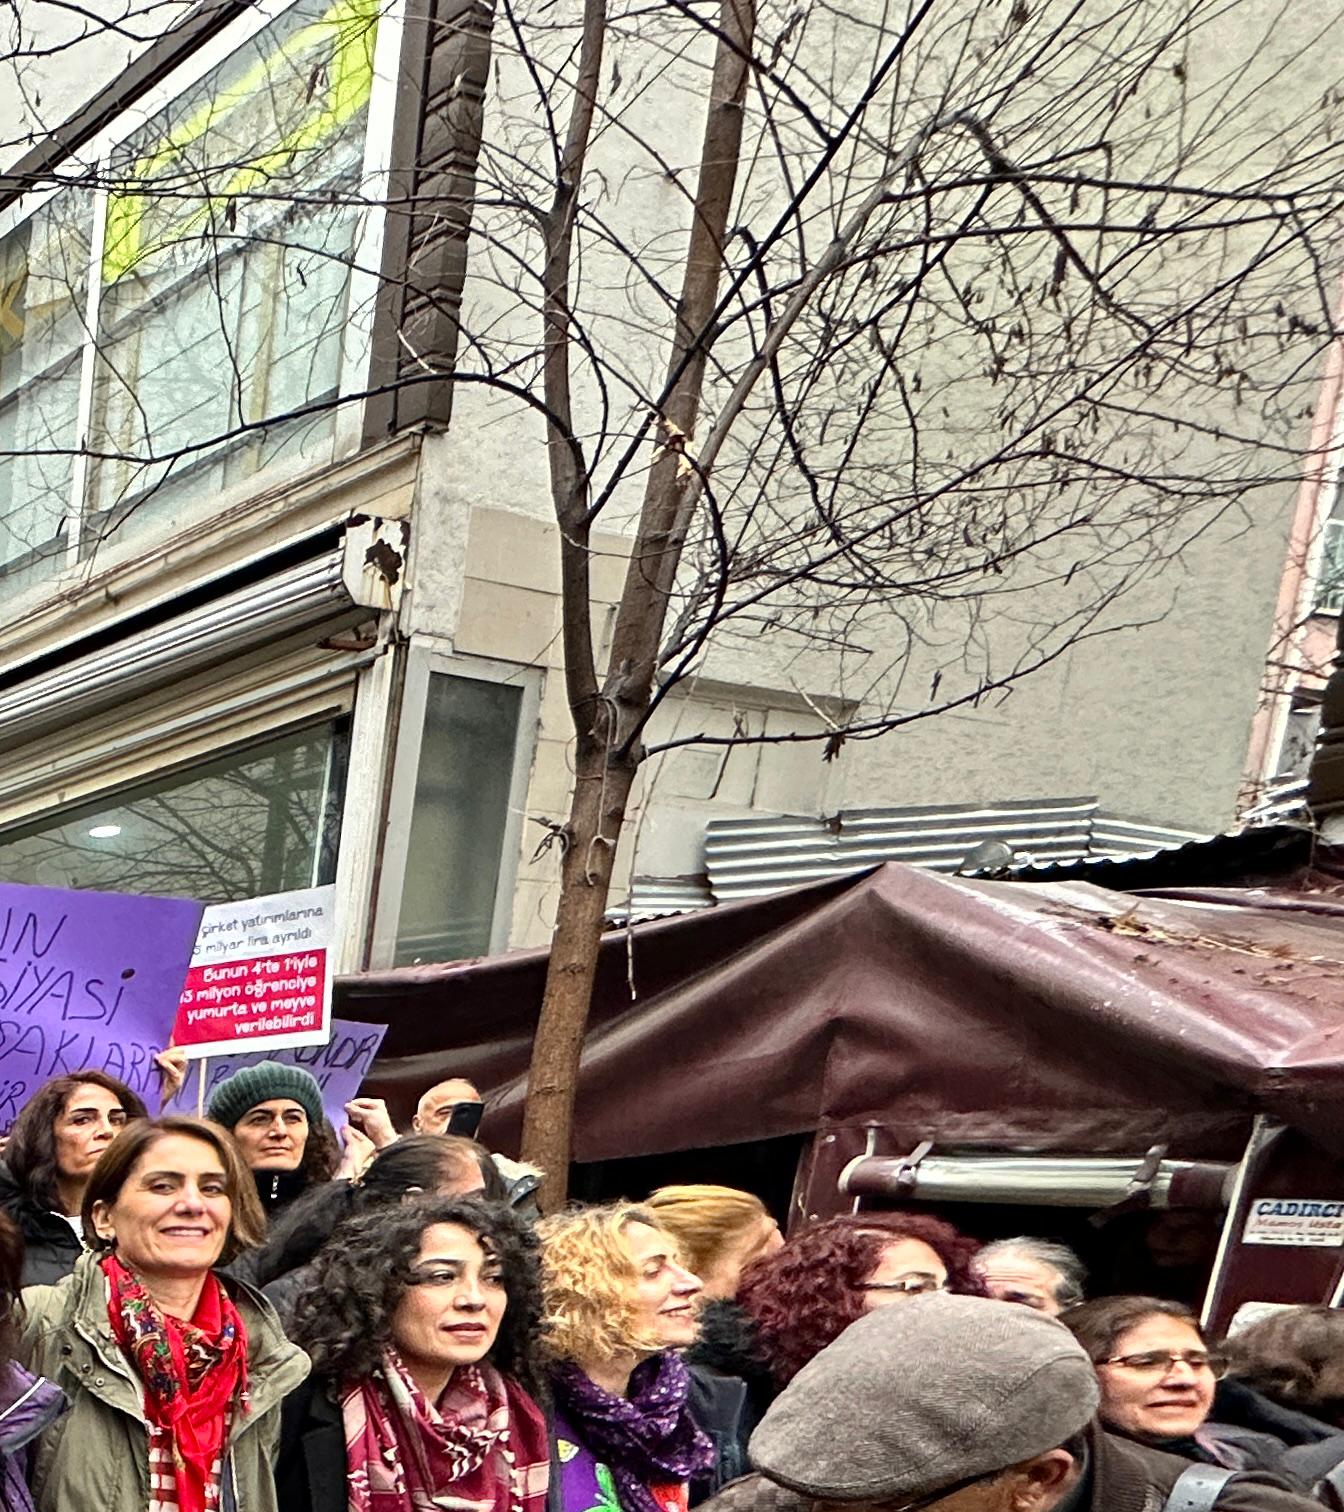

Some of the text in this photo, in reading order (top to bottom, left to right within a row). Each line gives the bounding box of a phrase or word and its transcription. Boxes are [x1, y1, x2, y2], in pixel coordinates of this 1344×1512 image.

[203, 965, 249, 983] Bunun
[196, 984, 242, 1004] milyon
[244, 974, 317, 999] öğrenciye
[187, 995, 316, 1026] yumurta ve meyve
[234, 1011, 315, 1035] verilebilirdi
